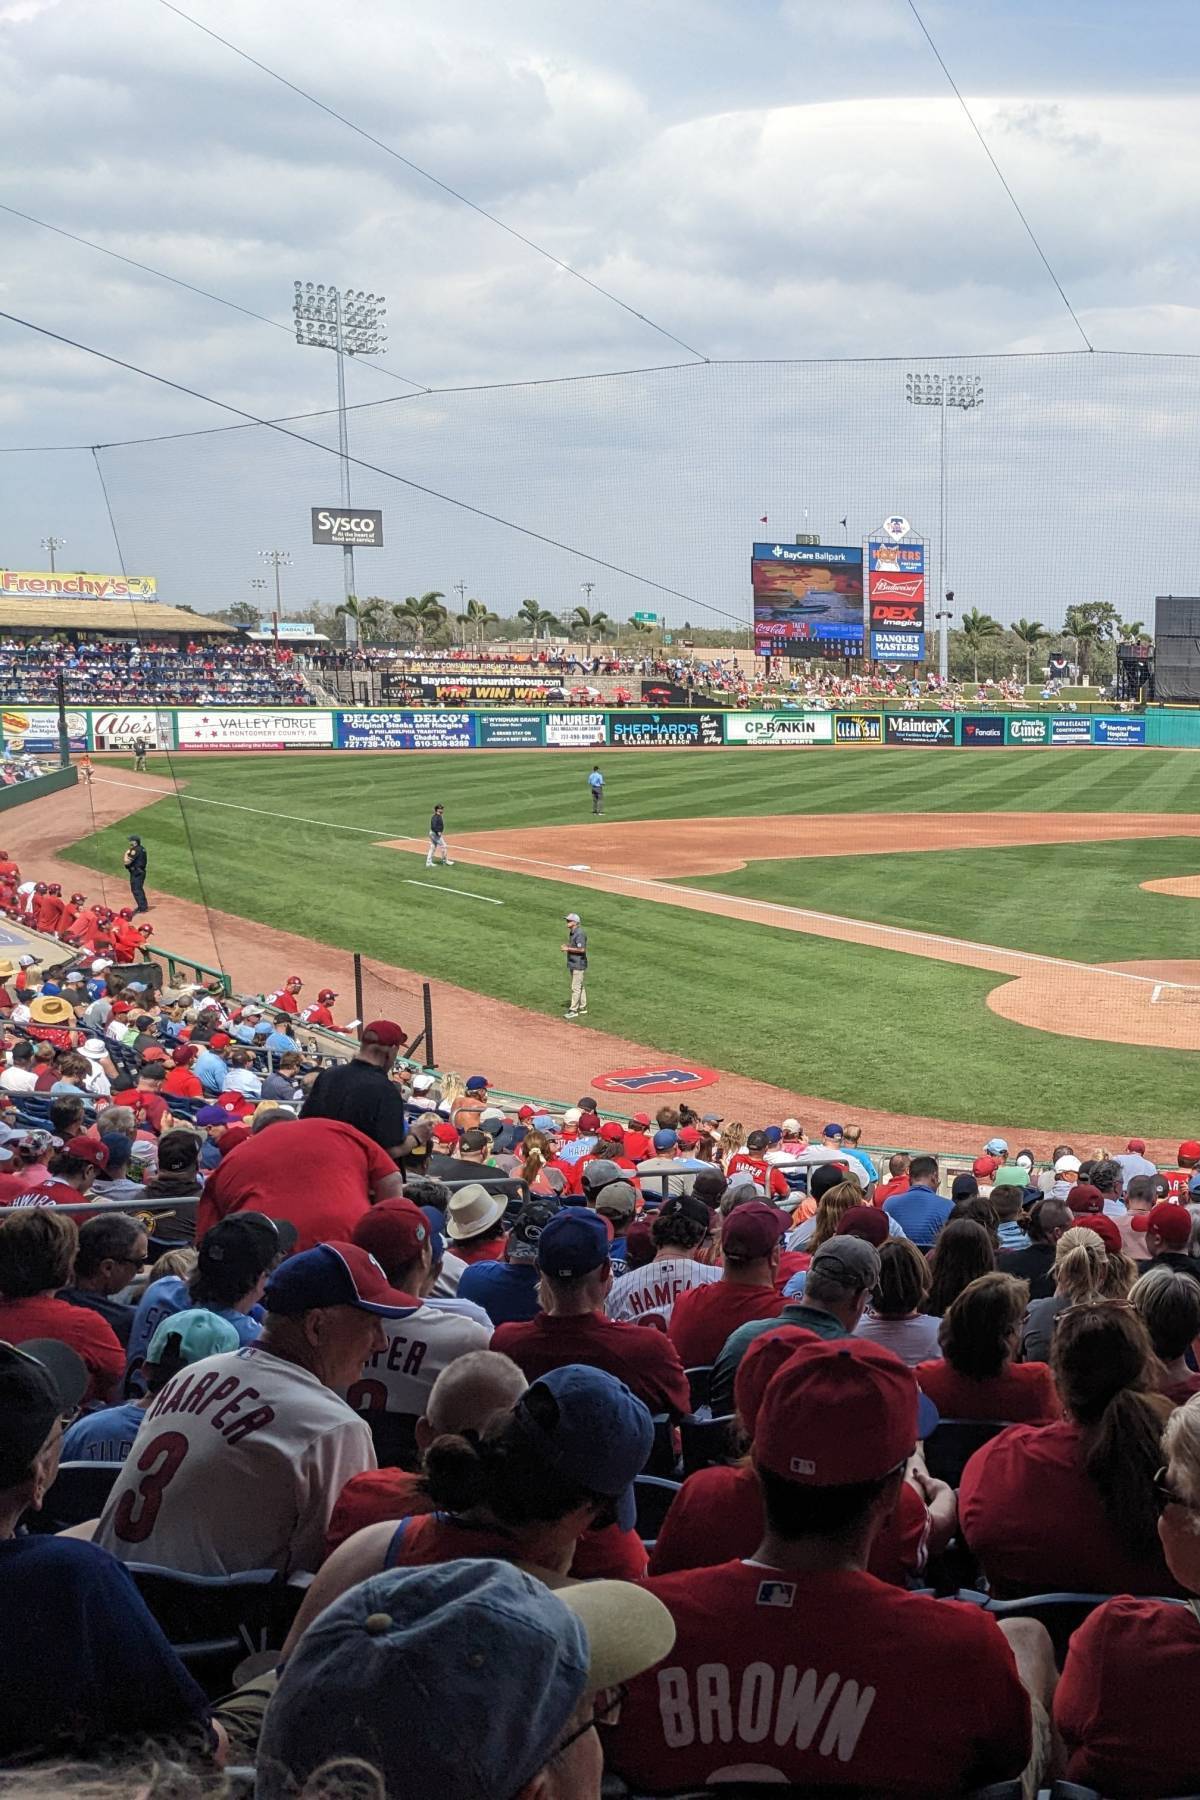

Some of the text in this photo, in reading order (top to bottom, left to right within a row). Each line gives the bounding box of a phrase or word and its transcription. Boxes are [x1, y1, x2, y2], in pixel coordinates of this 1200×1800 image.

[318, 512, 374, 534] Sysco
[783, 551, 846, 561] BayCare Ballpark
[2, 573, 129, 597] Frenchy's
[878, 582, 918, 592] Budweiser
[873, 606, 918, 620] DEX
[883, 619, 922, 628] imaging
[875, 634, 919, 643] BANQUET
[876, 643, 919, 652] MASTERS
[421, 676, 561, 687] BaystarRestaurantGroup.com
[436, 687, 548, 699] WIN! WIN! WIN!
[95, 713, 155, 735] Abe's
[219, 718, 316, 729] VALLEY FORGE
[343, 714, 469, 723] DELCO'S DELCO'S
[549, 714, 604, 725] INJURED?
[614, 724, 698, 735] SHEPHARD'S
[745, 722, 815, 733] CP-RANKIN
[888, 718, 950, 734] MaintenX
[1011, 721, 1046, 737] Times
[975, 728, 1001, 737] Fanatics
[736, 1162, 762, 1177] HARPER
[629, 1279, 693, 1315] HAME
[148, 1371, 275, 1446] HARPER
[114, 1431, 189, 1544] 3
[657, 1661, 877, 1762] BROWN
